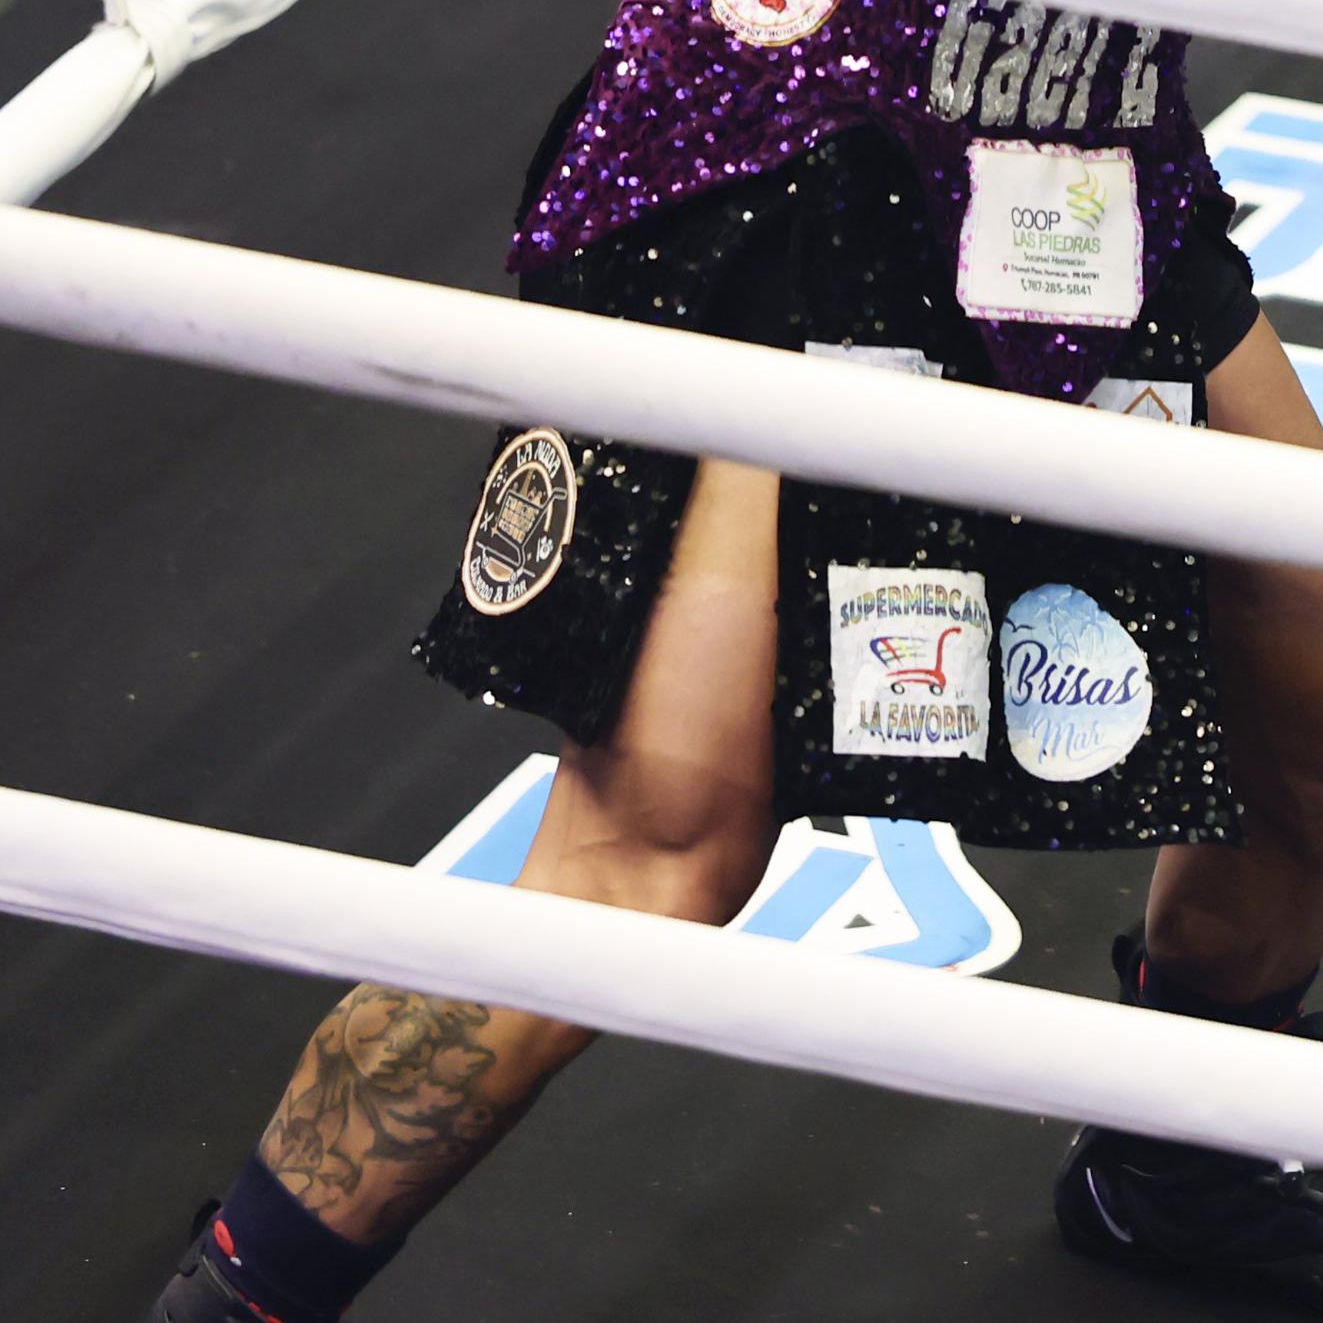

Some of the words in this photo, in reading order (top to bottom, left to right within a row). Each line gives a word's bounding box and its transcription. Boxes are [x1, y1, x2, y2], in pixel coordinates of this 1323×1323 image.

[1011, 207, 1061, 231] COOP
[1013, 229, 1036, 249] LAS
[1038, 233, 1101, 255] PIEDRAS
[1007, 639, 1142, 707] Brisas
[860, 701, 885, 740] LA
